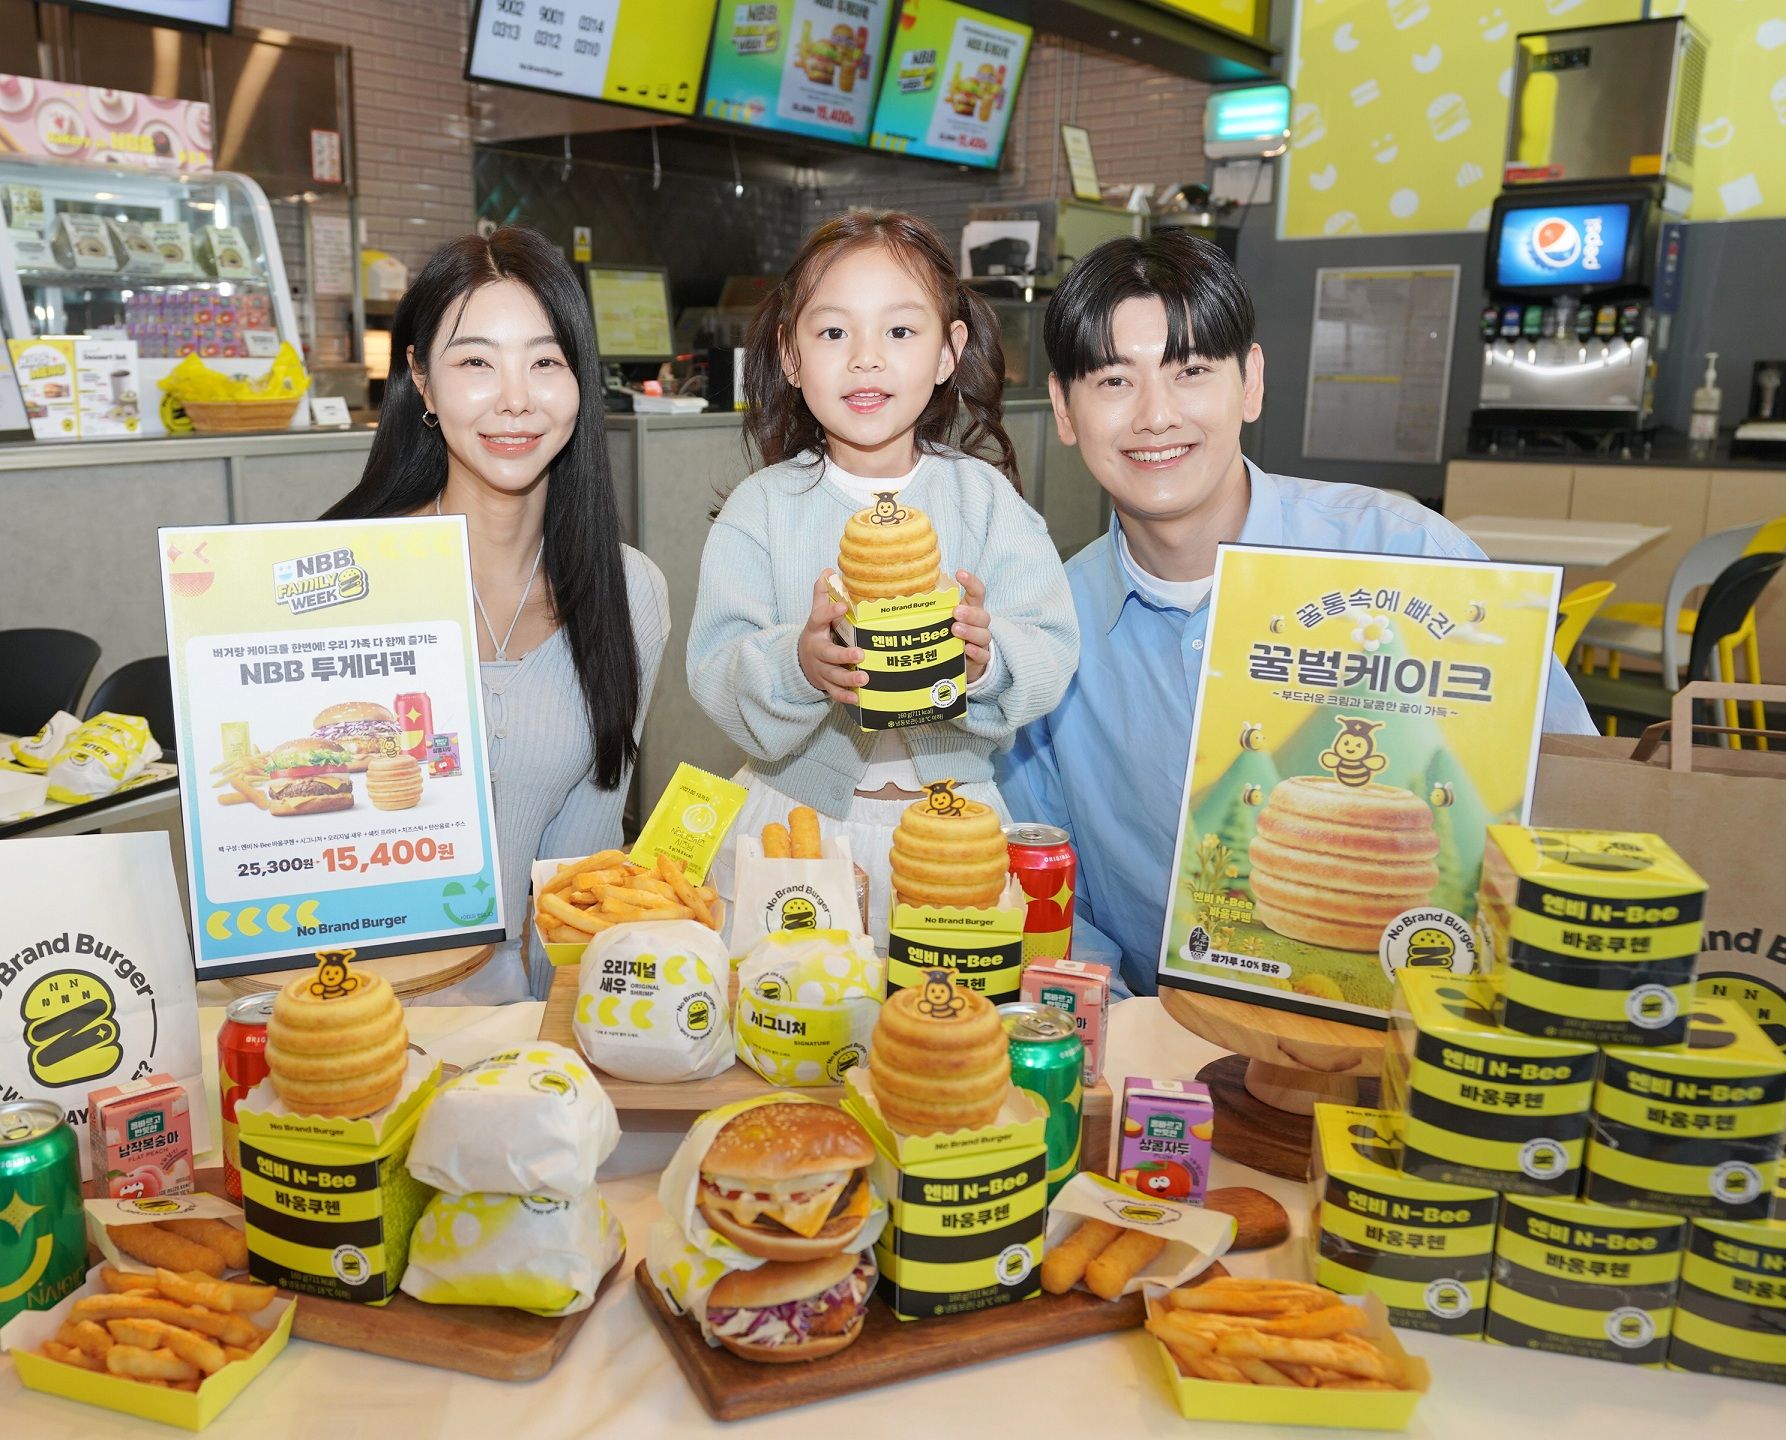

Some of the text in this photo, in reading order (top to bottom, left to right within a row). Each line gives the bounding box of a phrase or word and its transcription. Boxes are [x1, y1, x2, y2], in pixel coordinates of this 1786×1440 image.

[539, 6, 565, 25] 9001
[579, 15, 604, 34] 0314
[492, 20, 601, 57] 0313 0312 0310
[1582, 216, 1604, 271] pepsi
[296, 548, 352, 578] NBB
[276, 572, 338, 599] FAMILY
[290, 589, 338, 611] WEEK
[891, 602, 912, 612] Brand
[912, 599, 937, 611] Burger
[1295, 587, 1456, 641] 꿀통속에 빠진
[212, 633, 438, 658] 버거랑 케이크를 한번에! 우리 가족 다 함께 즐기는
[871, 626, 949, 649] 엔비 N-Bee
[240, 650, 417, 685] NBB 투게더팩
[886, 649, 938, 668] 바움쿠헨
[1249, 643, 1492, 702] 꿀벌케이크
[1282, 690, 1448, 717] 부드러운 크림과 달콤한 꿀이 가득
[328, 832, 350, 842] 오리지널
[237, 837, 455, 877] 25,300원 15,400원
[1044, 853, 1071, 863] ORIGINAL
[765, 884, 829, 913] No Brand Burger
[1215, 894, 1253, 911] N-Bee
[1541, 893, 1680, 925] 엔비 N-Bee
[297, 914, 407, 937] No Brand Burger
[925, 916, 994, 927] No Brand Burger
[1209, 907, 1251, 924] 바움쿠헨
[1388, 912, 1476, 952] No Brand Burger
[1563, 931, 1651, 953] 바움쿠헨
[75, 933, 154, 996] Burger
[602, 959, 656, 979] 오리지널
[907, 946, 1003, 968] 엔비 N-Bee
[1210, 953, 1280, 974] 쌀가루 10% 함유
[600, 977, 626, 994] 새우
[630, 983, 660, 991] ORIGINAL
[677, 1001, 686, 1012] No
[683, 991, 703, 1004] Brand
[751, 1010, 806, 1036] 시그니처
[1442, 1048, 1572, 1081] 엔비 N-Bee
[1460, 1083, 1544, 1108] 바움쿠헨
[1627, 1071, 1765, 1102] 엔비 N-Bee
[67, 1108, 88, 1125] AY
[1648, 1107, 1736, 1131] 바움쿠헨
[284, 1124, 312, 1133] Brand
[313, 1126, 344, 1137] Burger
[951, 1138, 979, 1149] Brand
[981, 1133, 1013, 1144] Burger
[119, 1131, 179, 1158] 납작복숭아
[257, 1156, 357, 1189] 엔비 N-Bee
[923, 1172, 1029, 1203] 엔비 N-Bee
[275, 1190, 341, 1216] 바움쿠헨
[942, 1203, 1010, 1229] 바움쿠헨
[1348, 1189, 1471, 1223] 엔비 N-Bee
[1366, 1226, 1446, 1250] 바움쿠헨
[1527, 1217, 1658, 1251] 엔비 N-Bee
[1546, 1252, 1631, 1279] 바움쿠헨
[1713, 1240, 1759, 1268] 엔비
